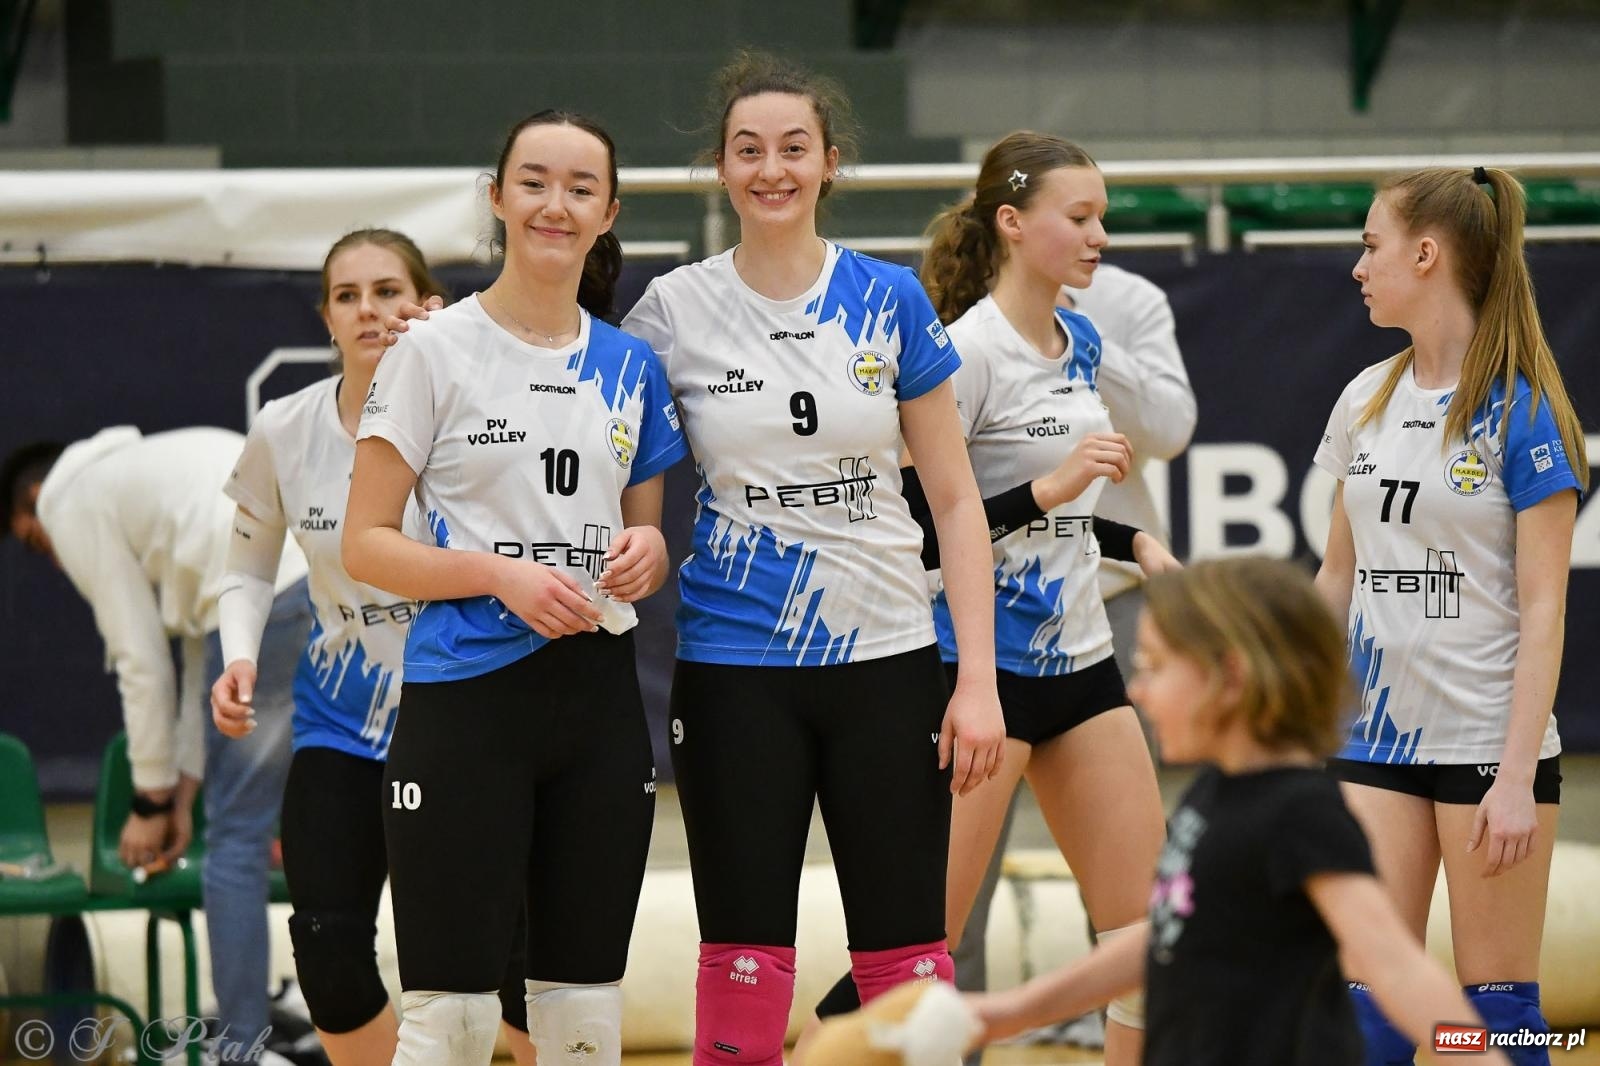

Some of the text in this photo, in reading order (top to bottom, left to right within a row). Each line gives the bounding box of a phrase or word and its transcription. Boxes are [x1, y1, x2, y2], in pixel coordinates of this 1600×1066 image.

[726, 368, 745, 382] PV
[529, 383, 577, 395] DECATHLON
[707, 380, 764, 395] VOLLEY
[789, 390, 819, 437] 9
[486, 418, 508, 432] PV
[1026, 424, 1070, 437] VOLLEY
[467, 430, 527, 447] VOLLEY
[1356, 452, 1370, 464] PV
[540, 447, 580, 497] 10
[1347, 464, 1377, 476] OLLEY
[1379, 478, 1421, 524] 77
[309, 507, 324, 517] PV
[300, 519, 337, 530] VOLLEY
[672, 718, 684, 745] 9
[391, 781, 422, 810] 10
[1489, 984, 1514, 992] asics
